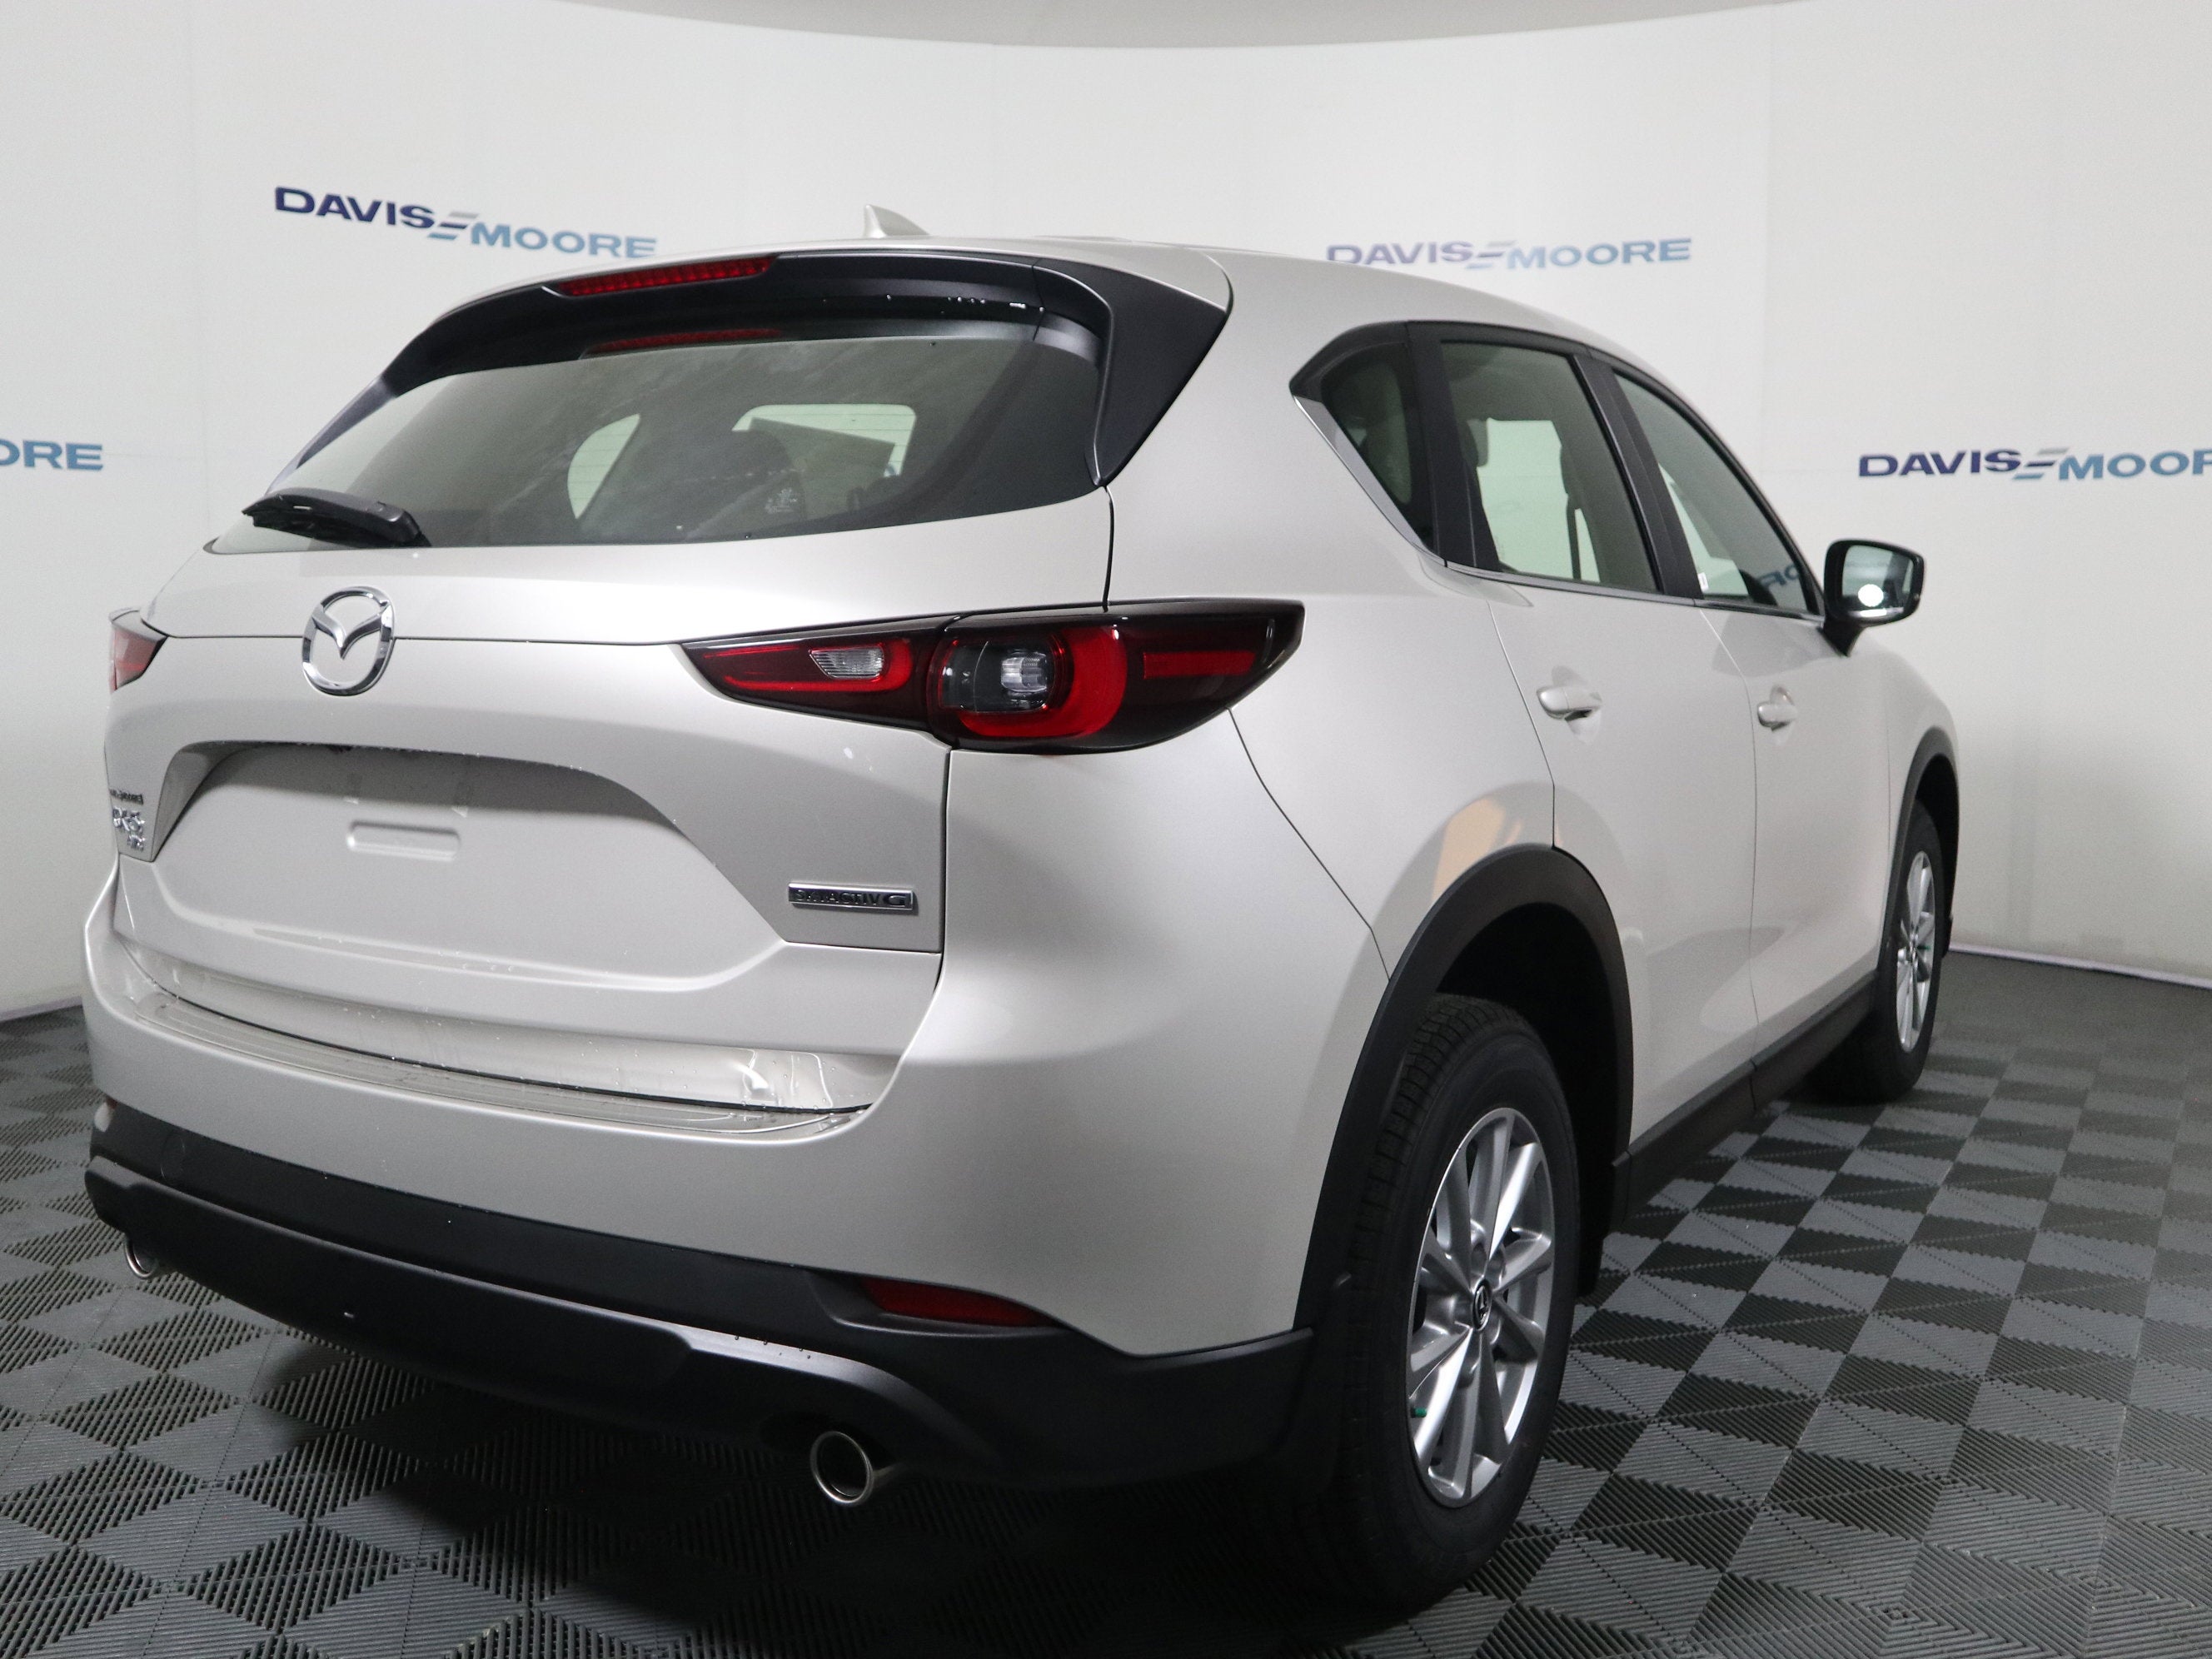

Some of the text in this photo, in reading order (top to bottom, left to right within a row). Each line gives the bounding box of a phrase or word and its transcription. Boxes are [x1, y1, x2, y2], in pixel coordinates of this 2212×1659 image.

[275, 187, 656, 258] DAVIS MOORE
[1328, 238, 1691, 268] DAVIS MOORE
[1859, 449, 2021, 476] DAVIS
